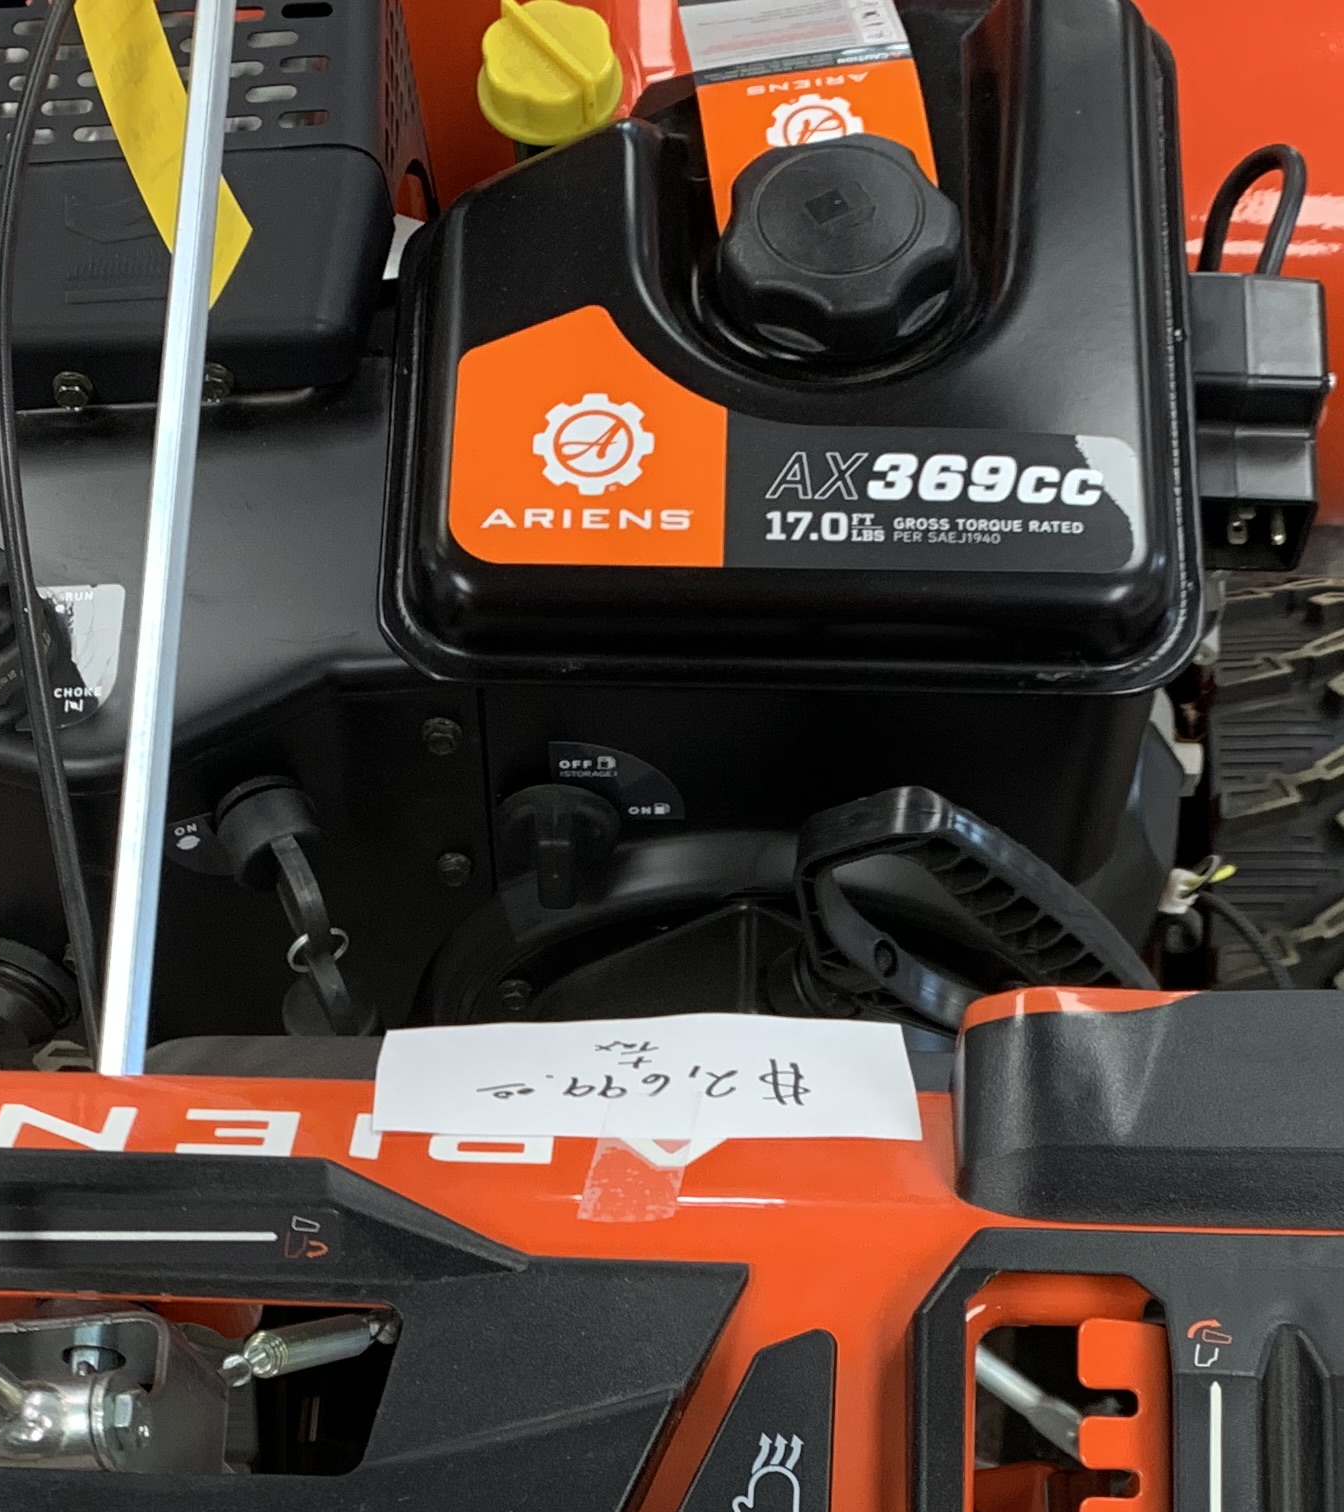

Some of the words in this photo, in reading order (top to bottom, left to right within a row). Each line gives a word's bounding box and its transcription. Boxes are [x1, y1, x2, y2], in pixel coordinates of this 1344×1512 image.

[746, 72, 869, 96] ARIENS
[480, 508, 692, 531] ARIENS
[765, 511, 848, 541] 17.0
[851, 513, 875, 526] FT
[893, 517, 950, 531] GROSS
[955, 518, 1023, 533] TORQUE
[1028, 520, 1085, 534] RATED
[851, 529, 885, 542] LBS
[893, 531, 922, 543] PER
[928, 531, 1002, 544] SAEJ1940
[64, 591, 94, 602] RUN
[53, 686, 103, 700] CHOKE
[559, 759, 593, 769] OFF
[627, 806, 652, 815] ON
[174, 823, 198, 837] ON
